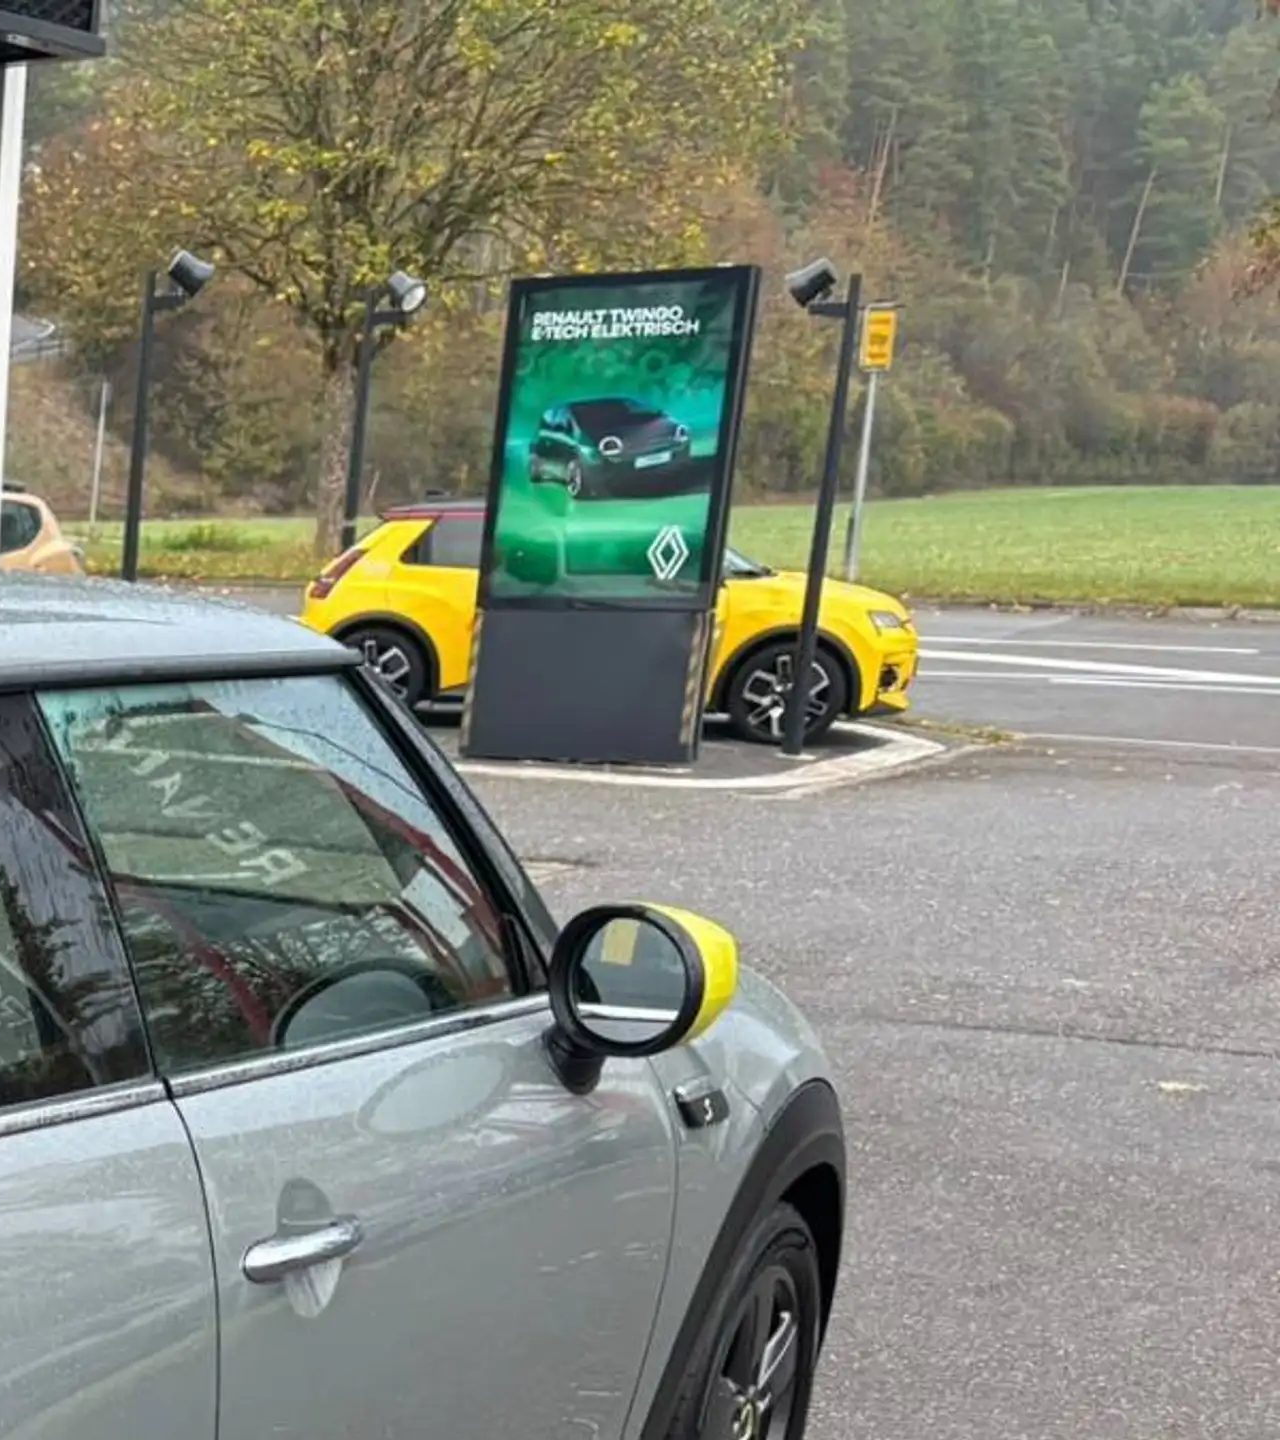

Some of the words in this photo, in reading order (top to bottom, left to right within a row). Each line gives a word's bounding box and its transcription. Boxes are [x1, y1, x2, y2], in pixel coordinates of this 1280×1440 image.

[532, 309, 608, 326] RENAULT
[609, 304, 684, 322] TWINGO
[590, 319, 700, 339] ELEKTRISCH
